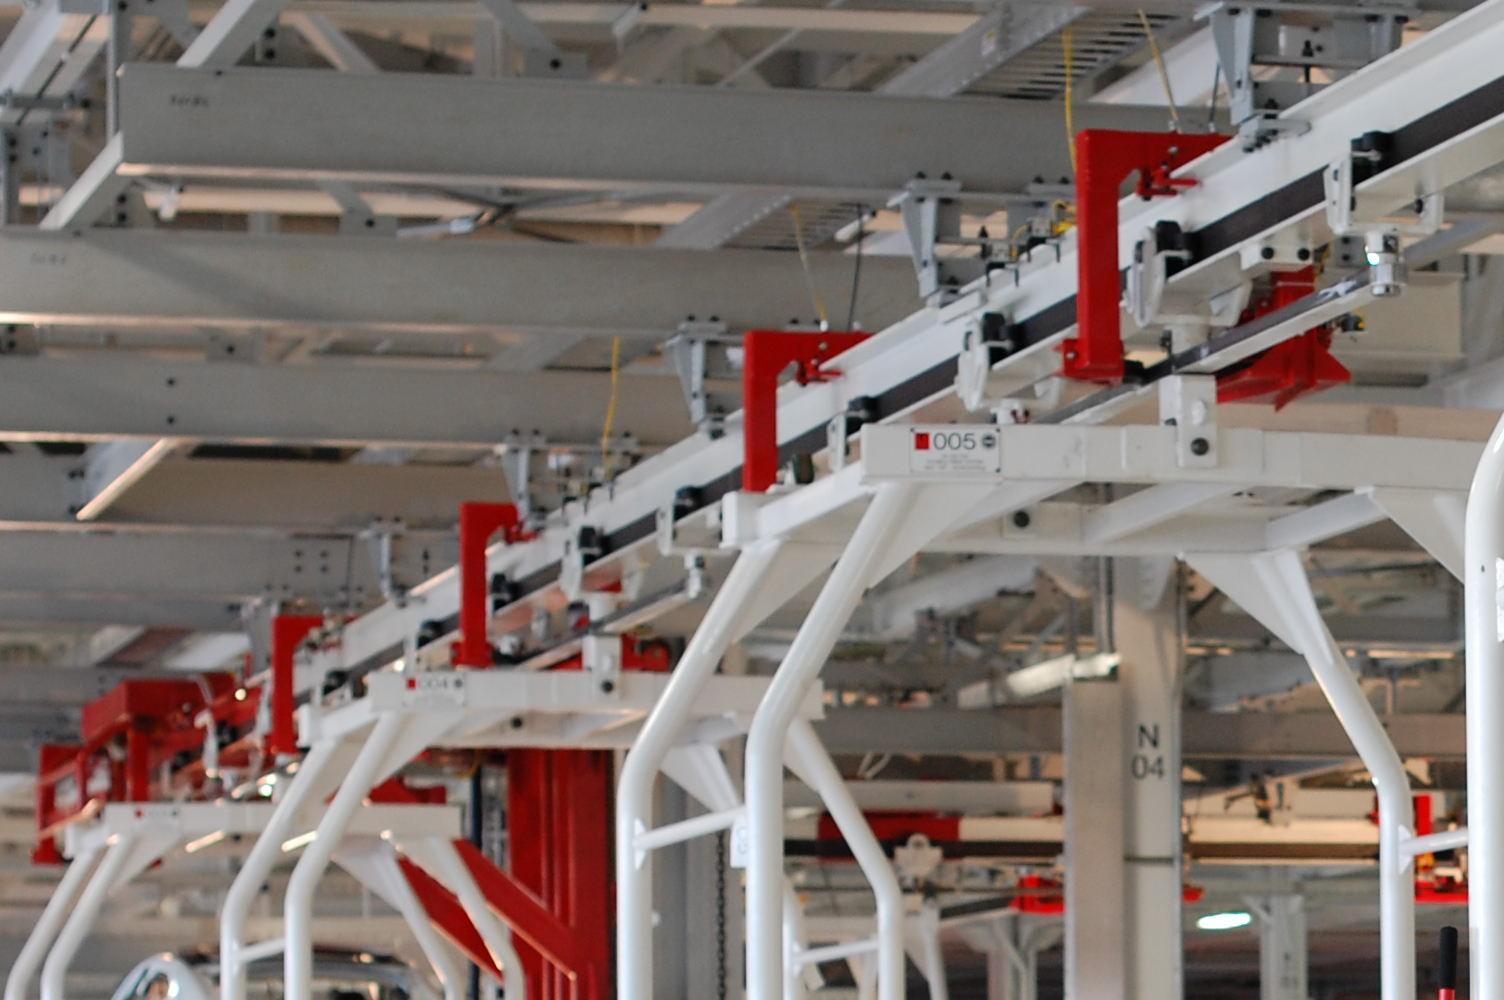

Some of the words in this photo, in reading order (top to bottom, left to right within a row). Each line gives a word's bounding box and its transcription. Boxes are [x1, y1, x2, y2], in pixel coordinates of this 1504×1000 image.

[933, 432, 976, 450] 005
[1138, 724, 1158, 749] N
[1131, 754, 1164, 780] 04
